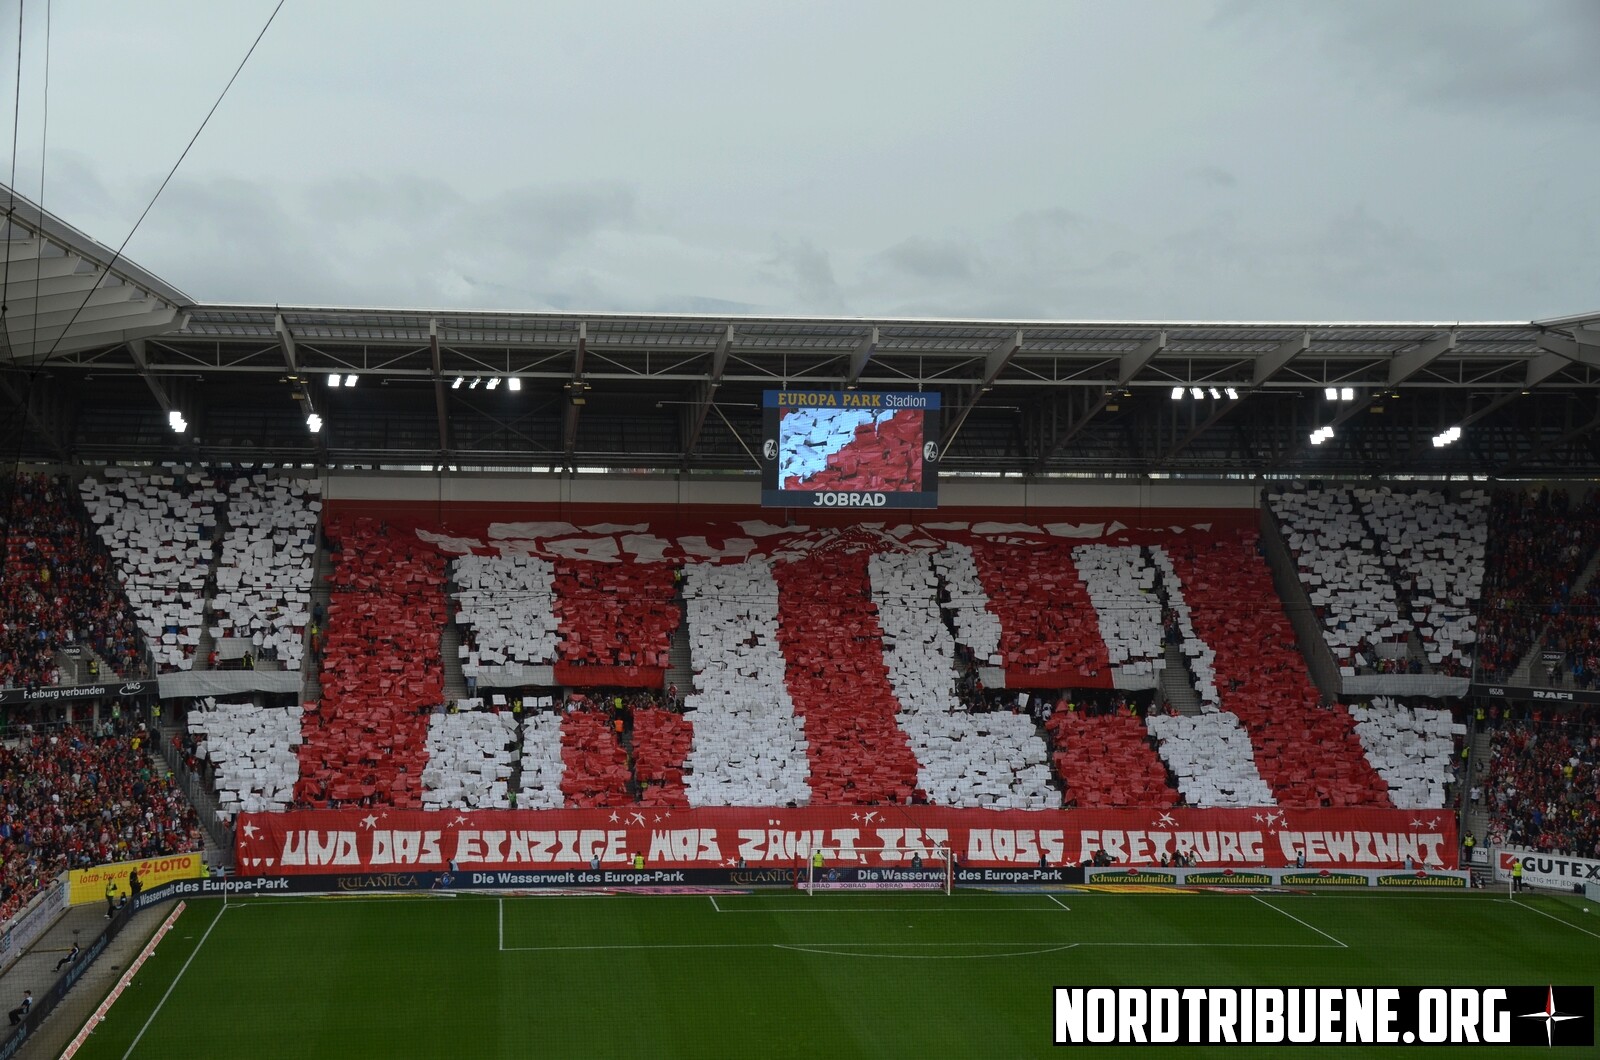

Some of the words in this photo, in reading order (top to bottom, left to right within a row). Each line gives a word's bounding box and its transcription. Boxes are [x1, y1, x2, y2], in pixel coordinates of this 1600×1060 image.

[778, 393, 837, 406] EUROPA
[842, 394, 881, 407] PARK
[885, 394, 926, 408] Stadion
[813, 492, 887, 507] JOBRAD
[60, 686, 105, 696] verbunden
[126, 682, 141, 690] VAG
[1533, 690, 1573, 700] RAFI
[370, 830, 443, 864] DAS
[1279, 831, 1445, 867] GEWINNT
[154, 857, 191, 874] LOTTO
[1522, 857, 1600, 879] GUTEX
[472, 873, 496, 884] Die
[498, 872, 575, 884] Wasserwelt
[578, 872, 600, 883] des
[604, 871, 684, 884] Europa-Park
[857, 870, 878, 881] Die
[959, 870, 981, 881] des
[985, 870, 1062, 882] Europa-Park
[1091, 874, 1174, 885] Schwarzwaldmilch
[1186, 874, 1269, 885] Schwarzwaldmilch
[1282, 875, 1366, 886] Schwarzwaldmilch
[1379, 876, 1463, 887] Schwarzwaldmilch
[337, 875, 418, 890] RULANTICA
[140, 884, 175, 905] Wasserwelt
[175, 881, 199, 893] des
[202, 877, 289, 892] Europa-Park
